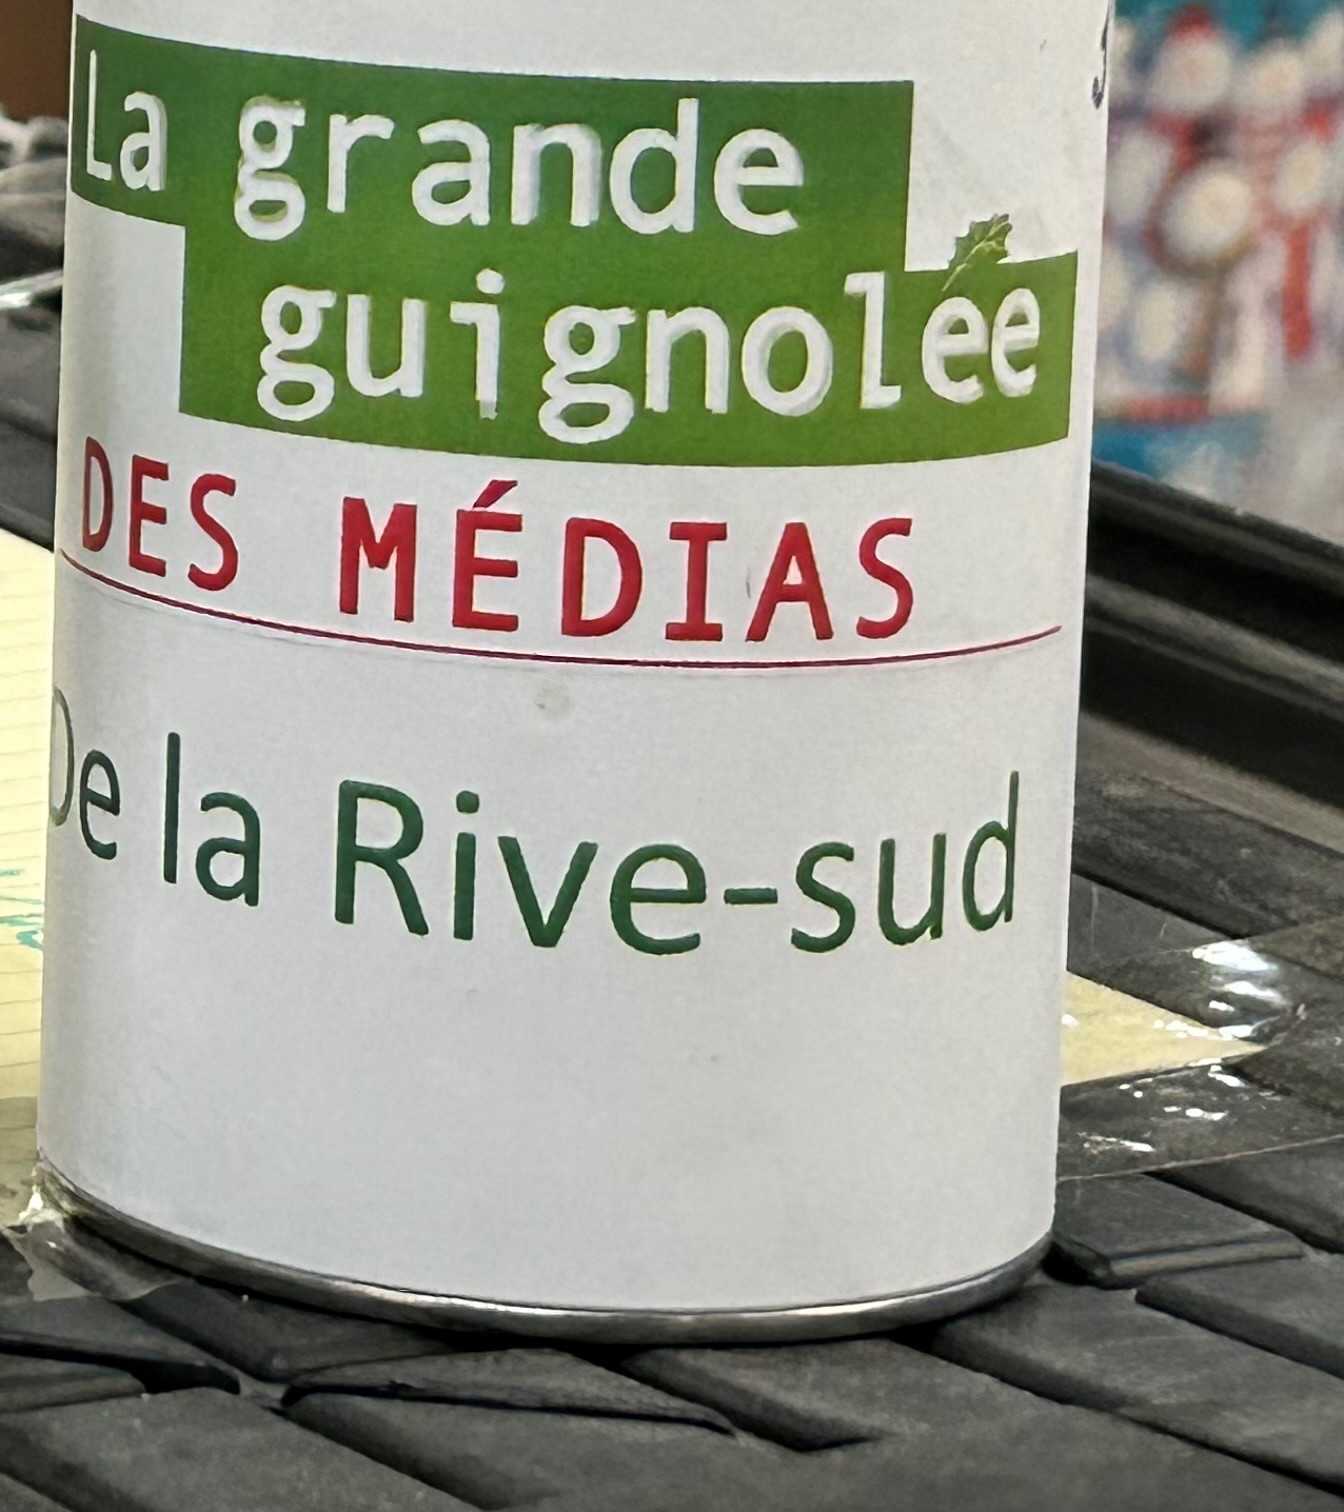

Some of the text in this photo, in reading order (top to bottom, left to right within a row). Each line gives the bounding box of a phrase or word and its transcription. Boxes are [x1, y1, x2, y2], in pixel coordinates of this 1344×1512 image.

[83, 49, 805, 242] La grande
[256, 266, 1042, 445] guignolée
[80, 436, 915, 642] DES MÉDIAS
[162, 731, 261, 908] la
[333, 769, 1021, 956] Rive-sud
